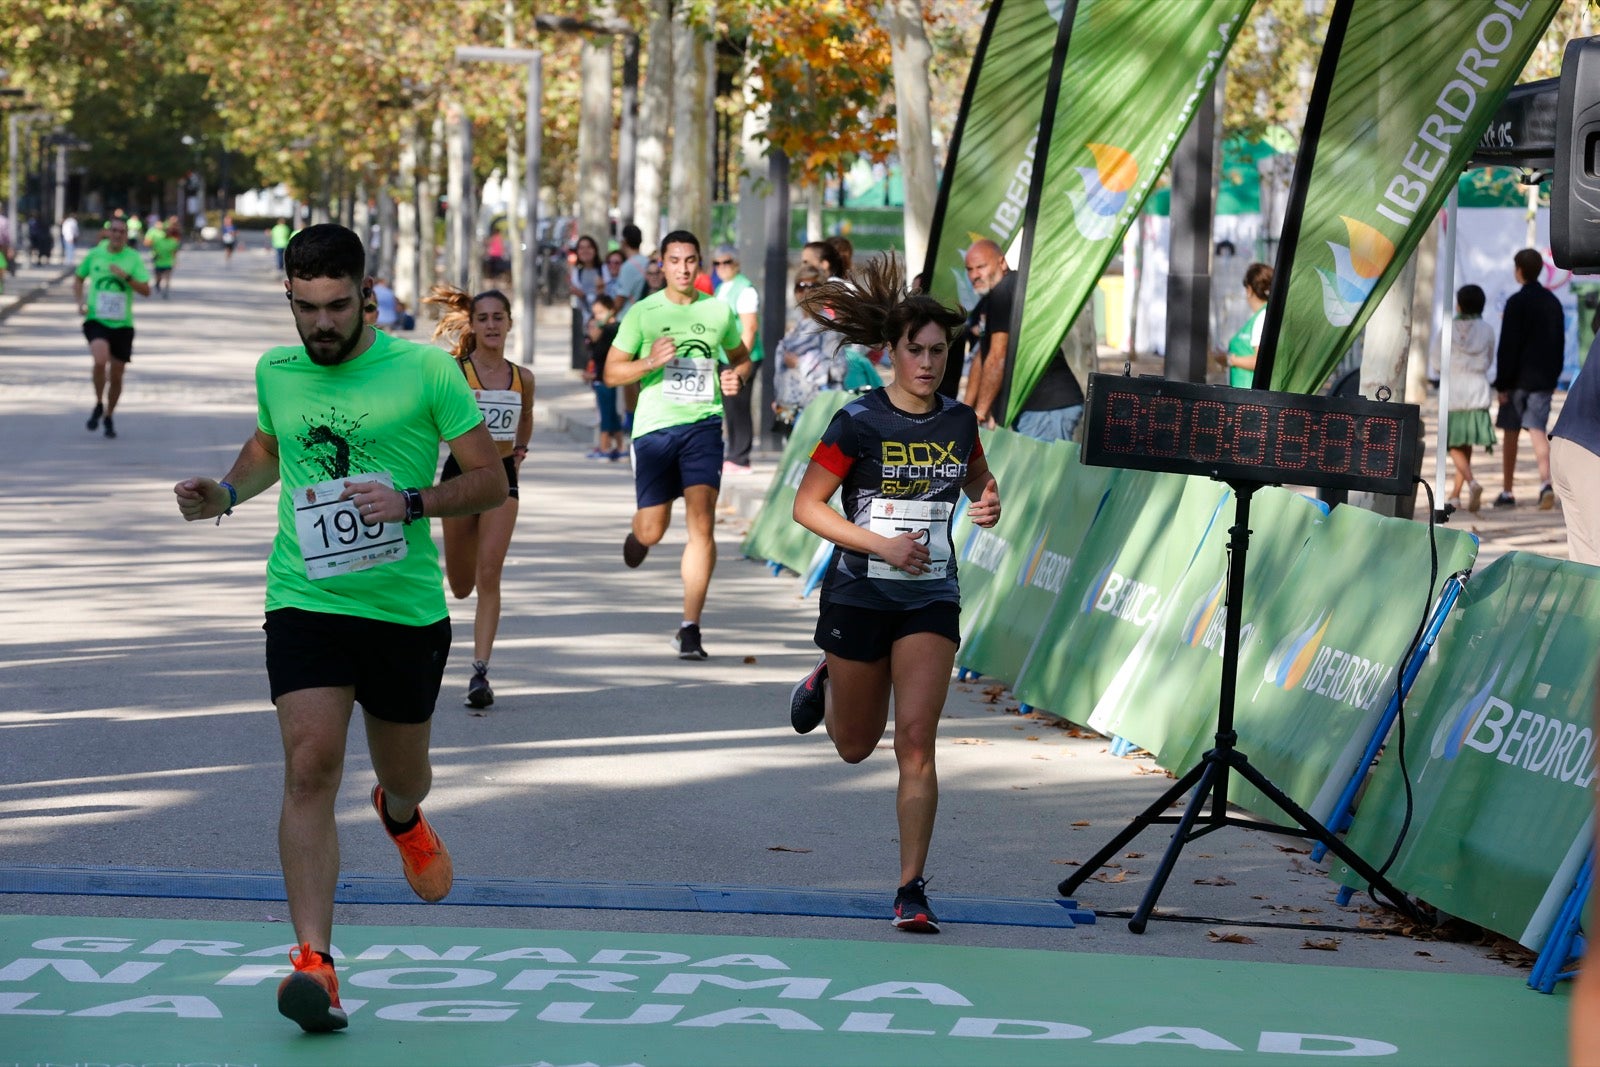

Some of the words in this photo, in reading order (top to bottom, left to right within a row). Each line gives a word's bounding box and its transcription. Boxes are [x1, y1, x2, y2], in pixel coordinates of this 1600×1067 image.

[1376, 0, 1531, 227] IBERDROL
[671, 373, 706, 392] 368
[881, 441, 962, 466] BOX
[313, 509, 385, 549] 199
[31, 936, 791, 970] GRANADA
[214, 963, 975, 1007] FORMA
